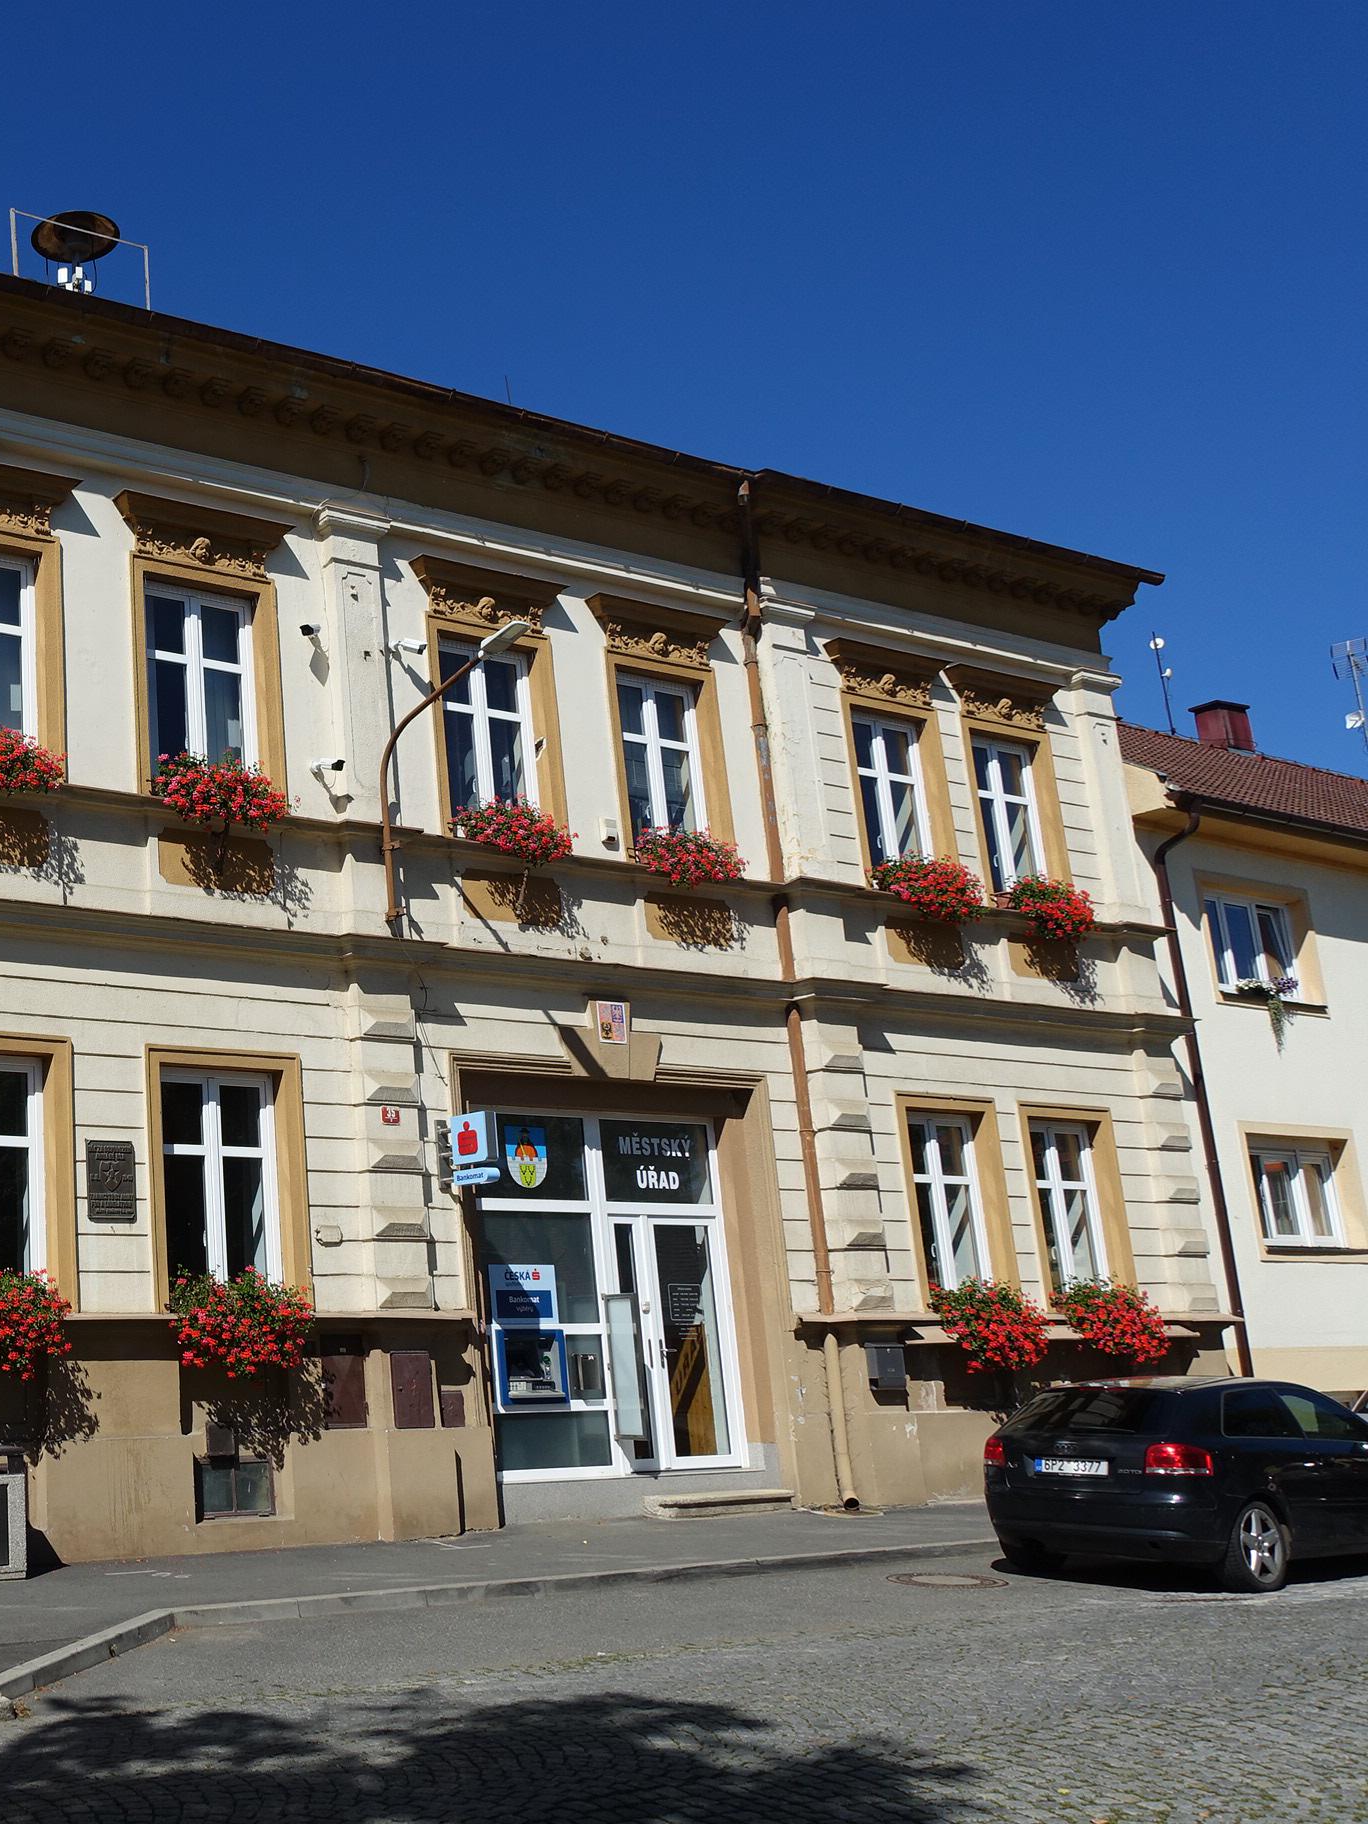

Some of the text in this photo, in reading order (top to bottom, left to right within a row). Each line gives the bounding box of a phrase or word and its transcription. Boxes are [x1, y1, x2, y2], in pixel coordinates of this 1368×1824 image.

[386, 1107, 395, 1118] 35
[618, 1132, 691, 1157] MĚSTSKÝ
[457, 1172, 484, 1181] Bankomat
[636, 1165, 679, 1190] ÚŘAD
[505, 1269, 531, 1280] ČESKÁ
[1044, 1459, 1065, 1471] 6P2
[1073, 1460, 1102, 1473] 3377
